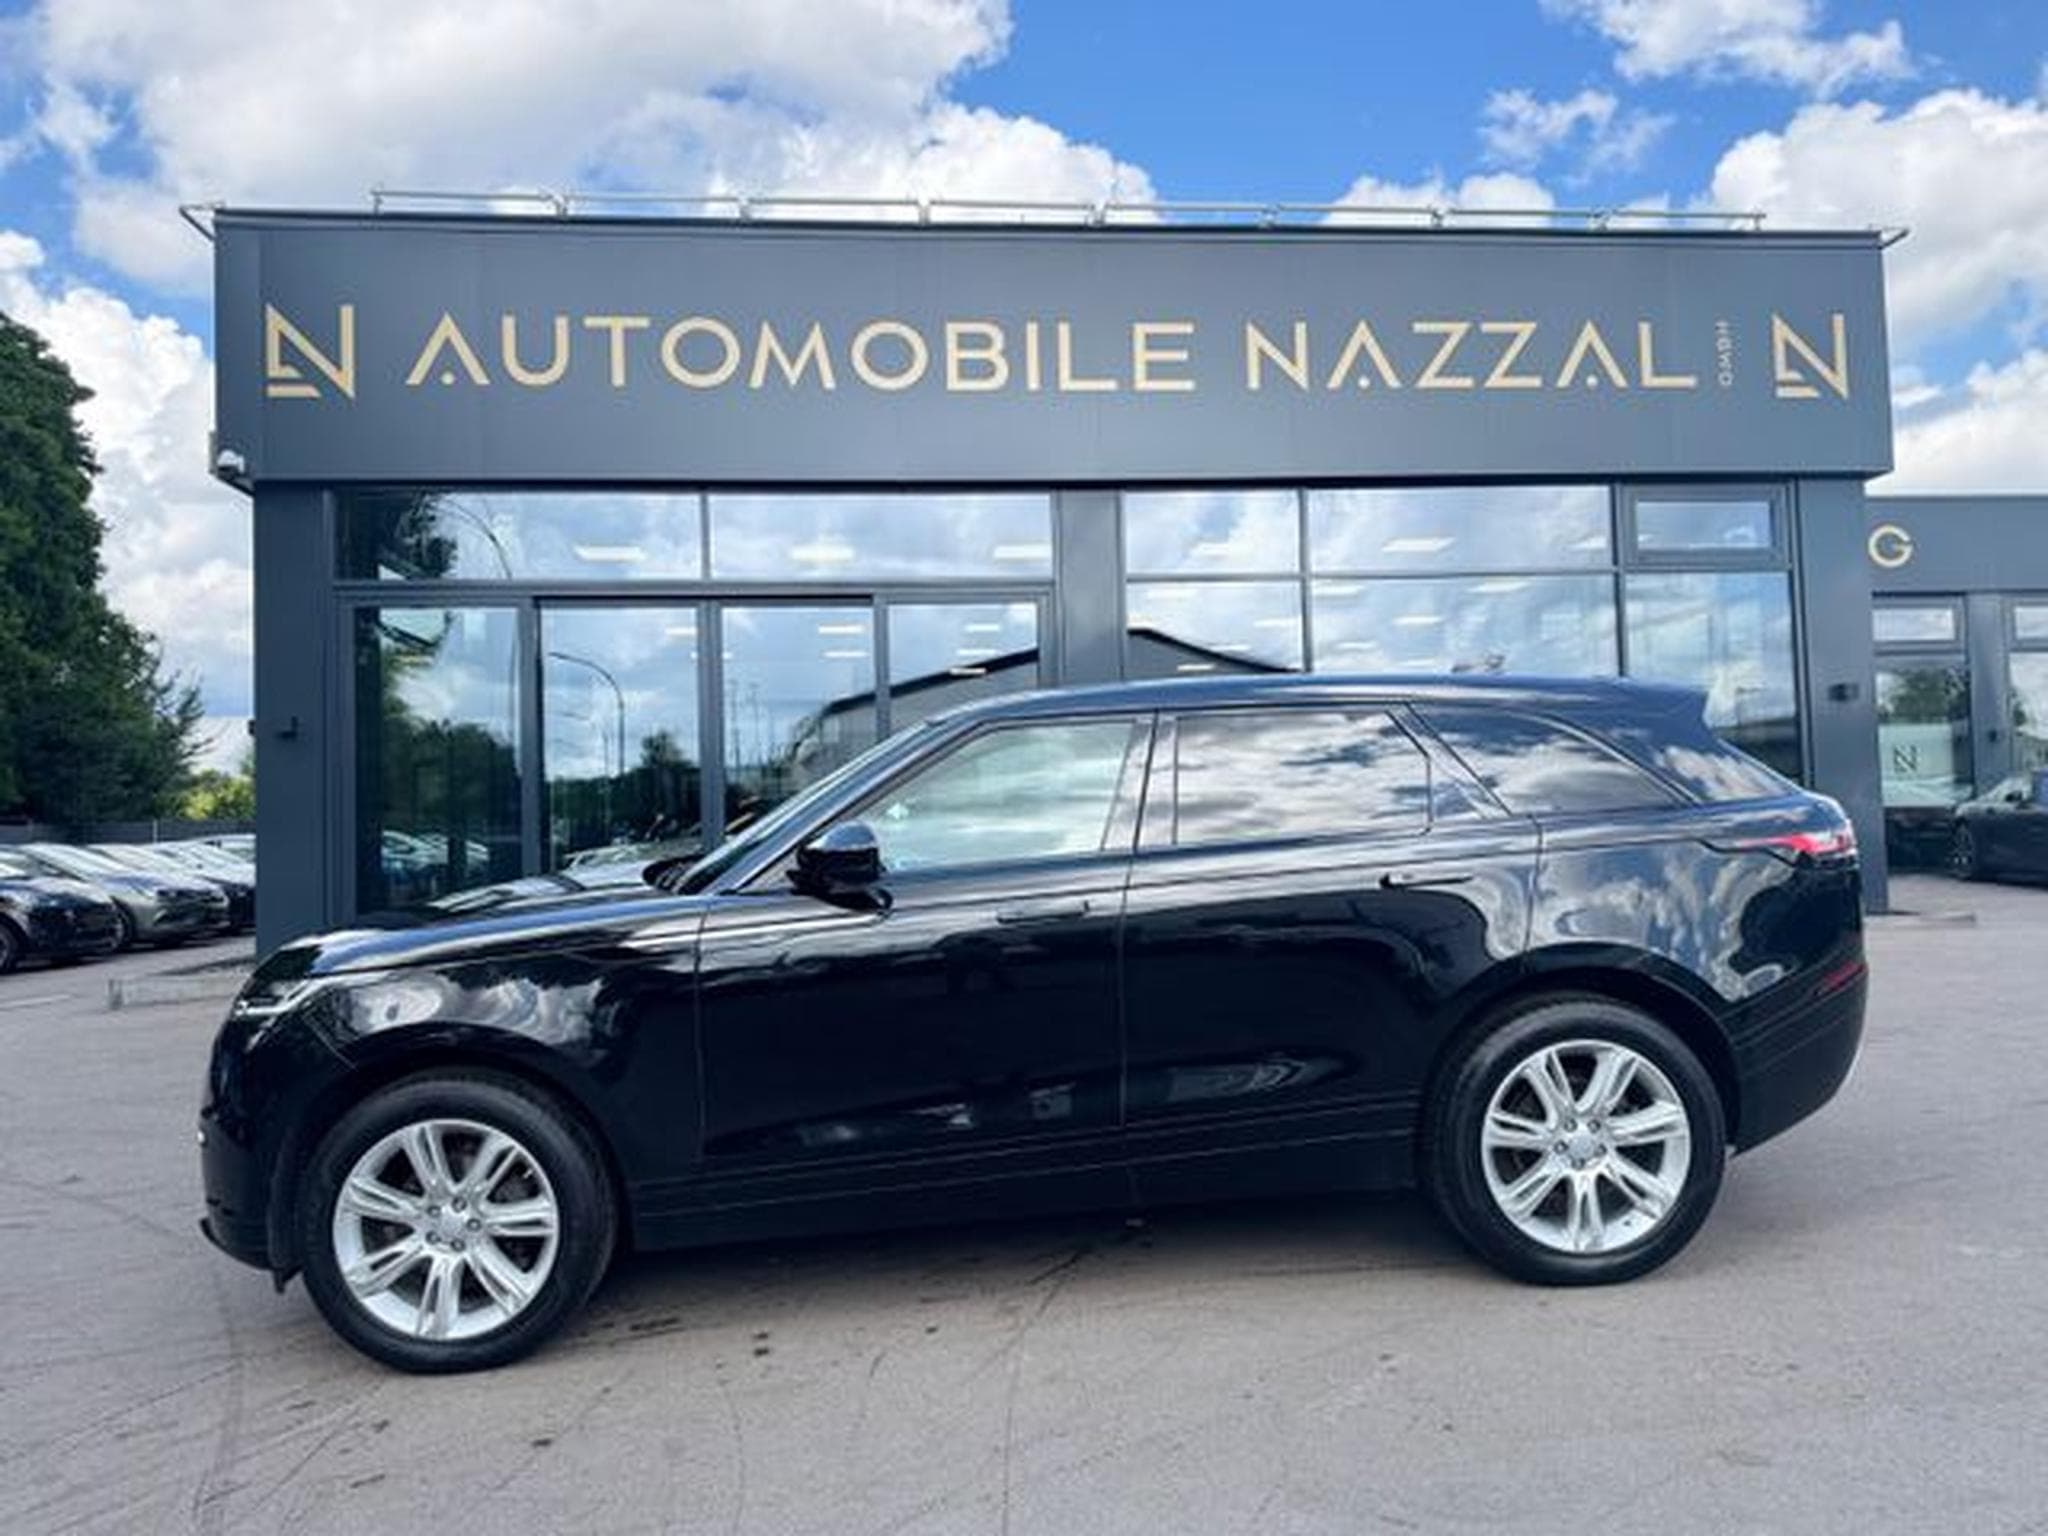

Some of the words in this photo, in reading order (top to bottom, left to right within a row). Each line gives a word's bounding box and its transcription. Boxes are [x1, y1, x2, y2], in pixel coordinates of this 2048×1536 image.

[405, 311, 1196, 392] AUTOMOBILE
[1246, 319, 1698, 391] NAZZAL
[1868, 525, 1913, 567] G
